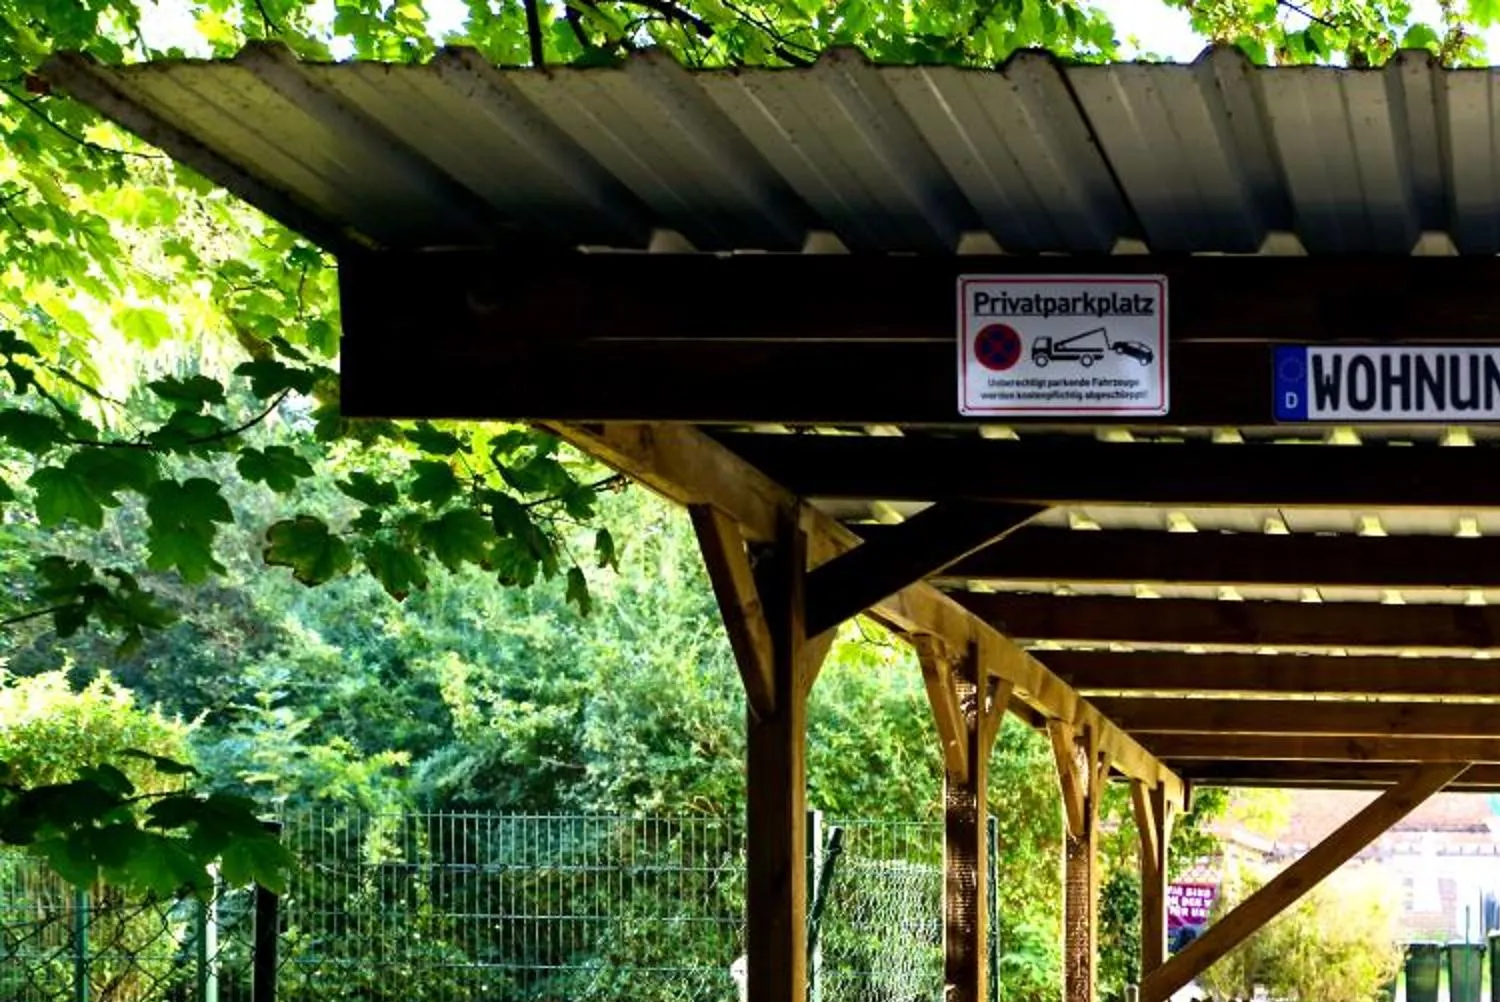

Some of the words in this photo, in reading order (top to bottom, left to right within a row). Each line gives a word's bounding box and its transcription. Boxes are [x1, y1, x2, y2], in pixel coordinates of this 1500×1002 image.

[973, 291, 1154, 318] Privatparkplatz
[1048, 377, 1091, 389] parkende
[1285, 392, 1298, 409] D
